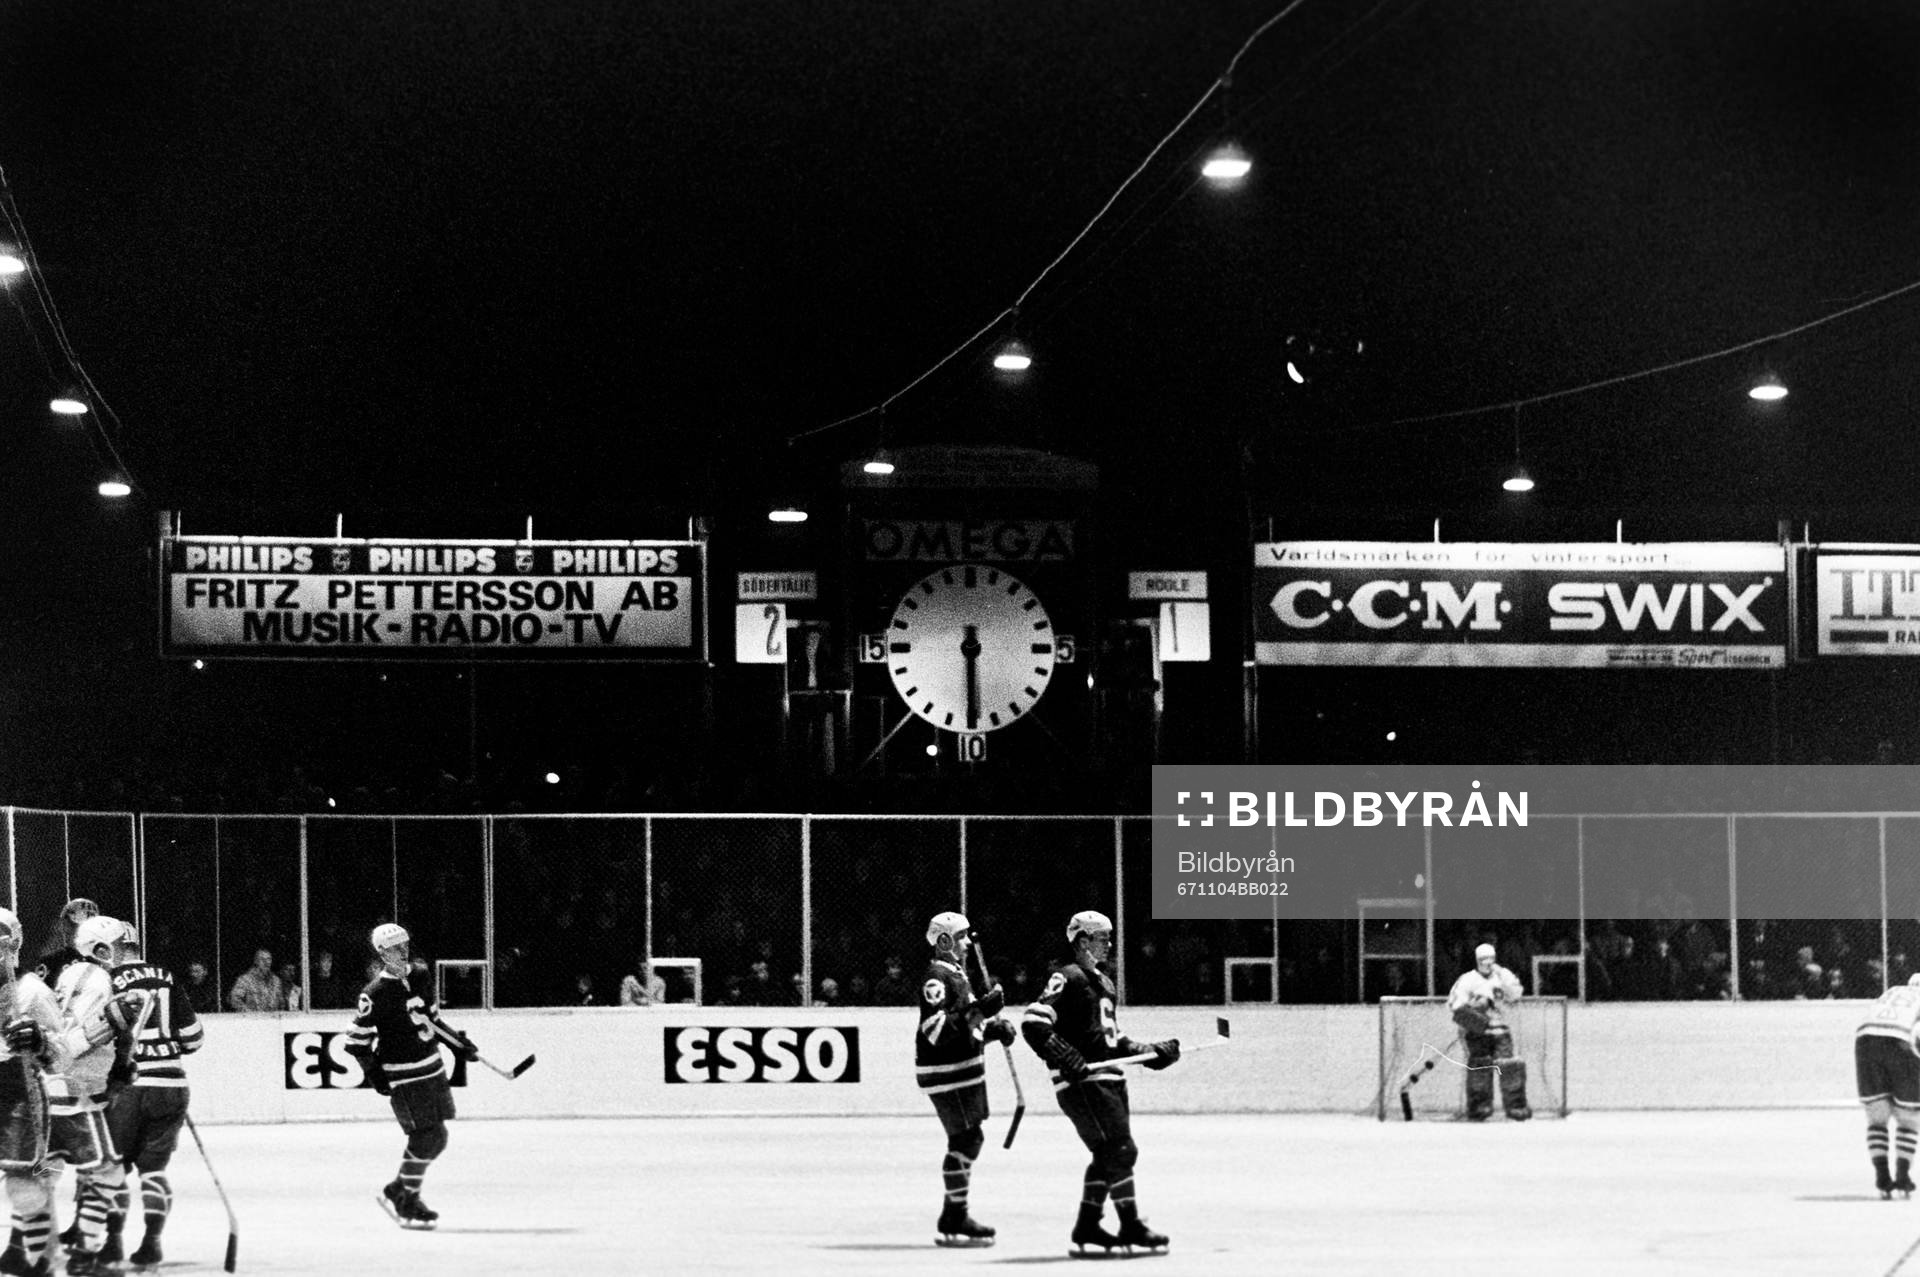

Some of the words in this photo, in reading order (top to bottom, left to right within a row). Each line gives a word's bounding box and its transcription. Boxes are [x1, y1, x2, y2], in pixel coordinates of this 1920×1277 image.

[868, 523, 1073, 558] OMEGA
[186, 546, 314, 572] PHILIPS
[369, 547, 497, 574] PHILIPS
[553, 548, 678, 574] PHILIPS
[185, 578, 300, 609] FRITZ
[328, 579, 594, 611] PETTERSSON
[620, 580, 679, 611] AB
[1548, 580, 1767, 632] SWIX
[764, 604, 782, 656] 2
[1169, 603, 1179, 653] 1
[1895, 630, 1920, 643] RA
[861, 635, 886, 660] 15
[1055, 637, 1073, 661] 5
[961, 735, 985, 760] 10
[113, 967, 174, 990] SCANIA
[675, 1026, 848, 1083] ESSO
